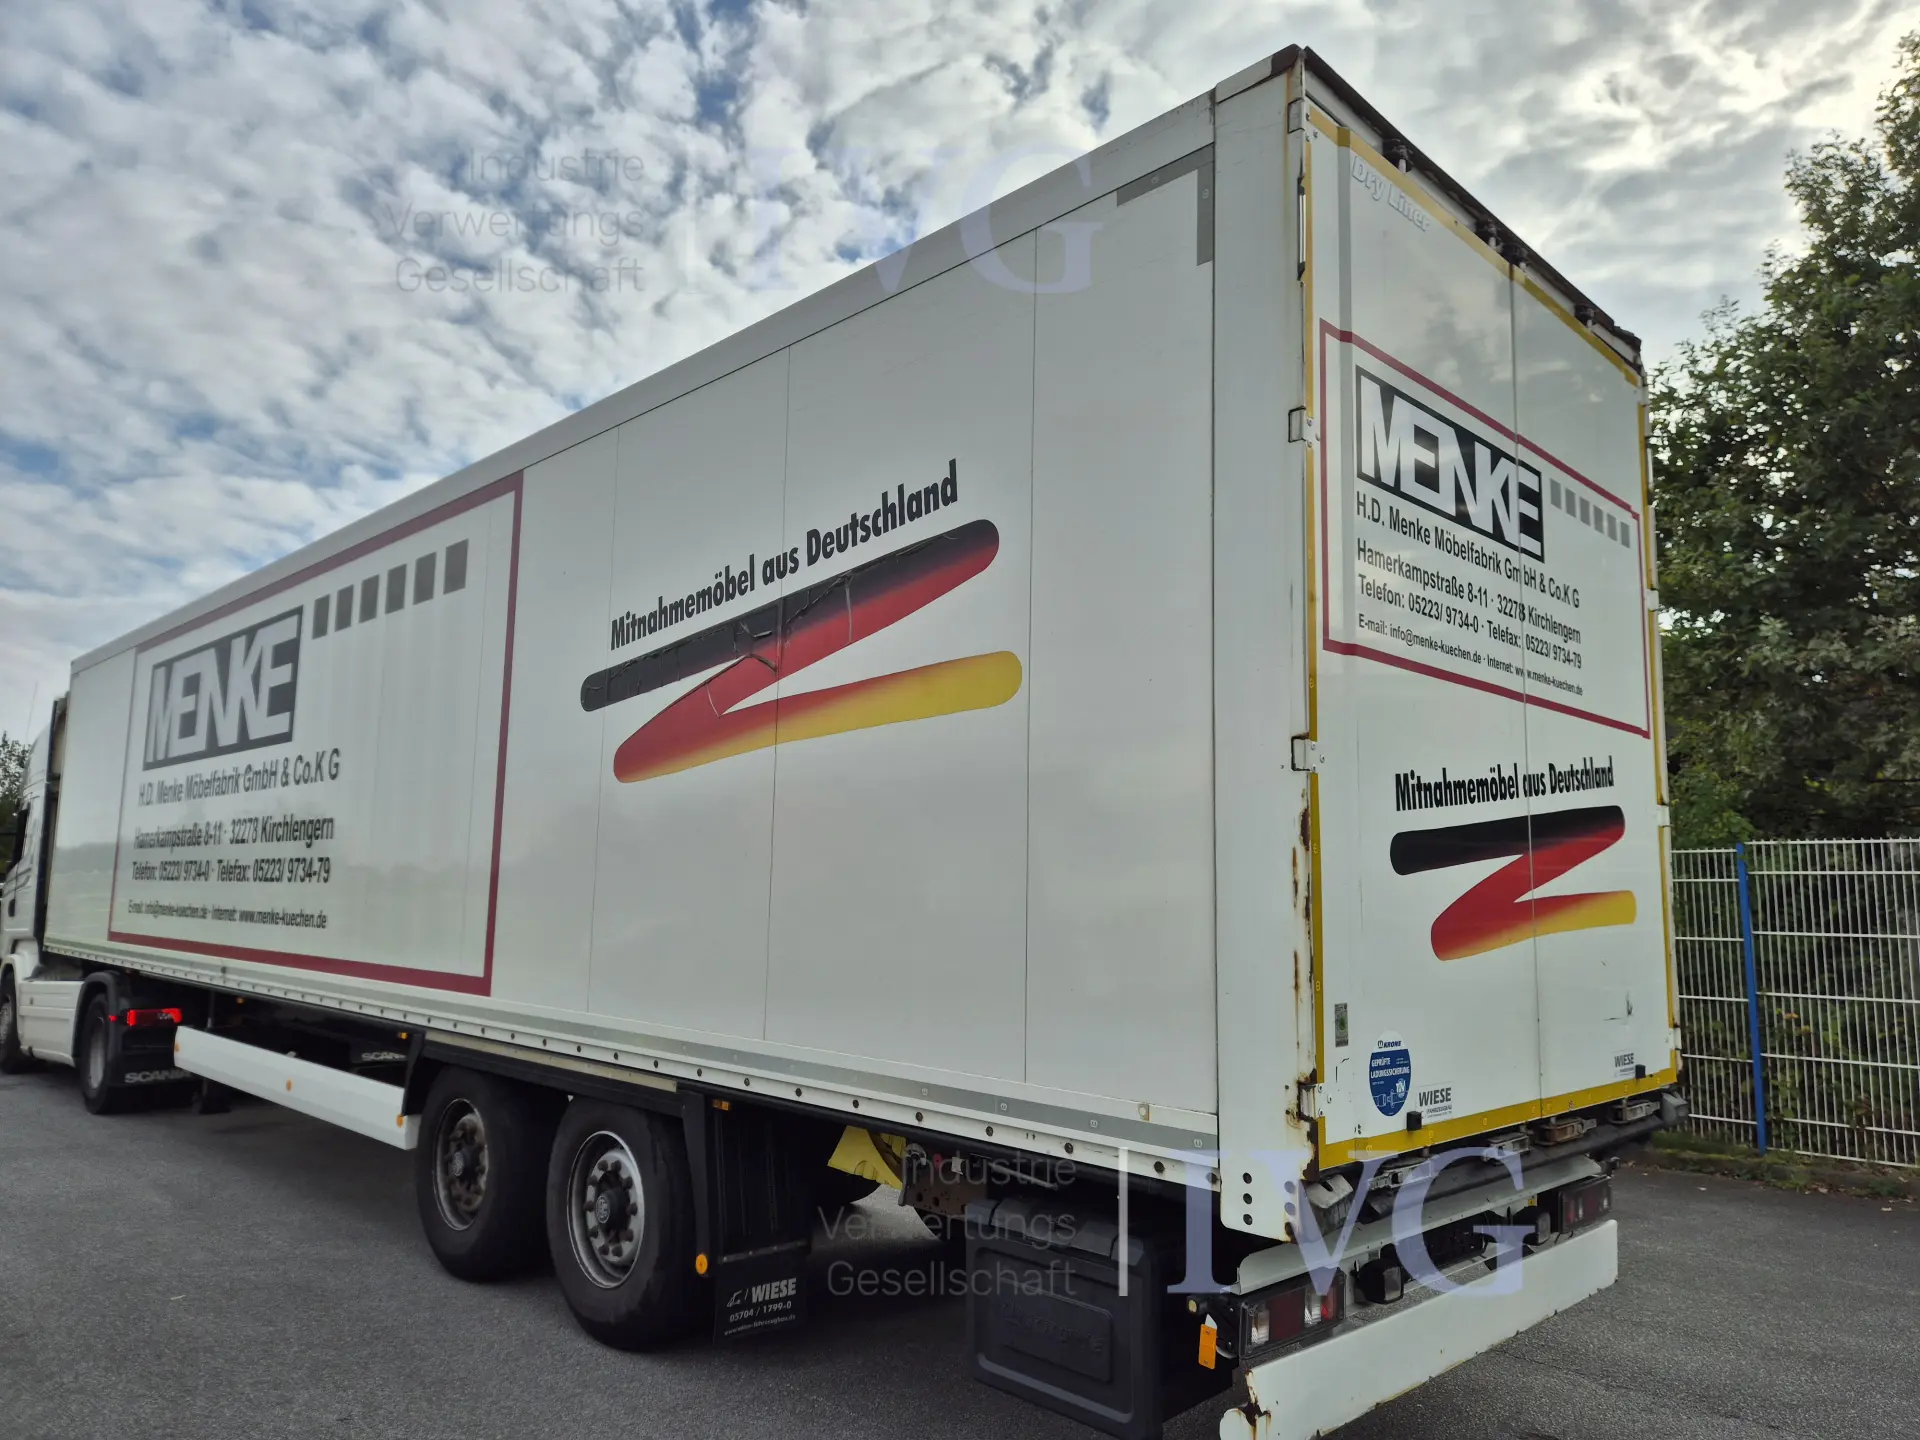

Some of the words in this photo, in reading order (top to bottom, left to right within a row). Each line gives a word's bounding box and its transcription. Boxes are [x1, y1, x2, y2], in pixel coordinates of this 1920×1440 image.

[1352, 156, 1386, 201] Dry
[1360, 374, 1541, 554] MENKE
[610, 552, 755, 651] Mitnahmemöbel
[762, 547, 799, 586] aus
[806, 458, 958, 567] Deutschland
[1356, 493, 1385, 526] H.D.
[1389, 505, 1431, 545] Menke
[1434, 525, 1501, 576] Möbelfabrik
[1539, 573, 1547, 593] &
[1357, 537, 1464, 600] Hamerkampstraße
[1467, 582, 1488, 609] 8-11
[1497, 594, 1526, 622] 32278
[1528, 605, 1581, 644] Kirchlengern
[1358, 573, 1405, 608] Telefon:
[1445, 608, 1479, 633] 9734-0
[1487, 620, 1522, 648] Telefax:
[1553, 644, 1582, 669] 9734-79
[1358, 613, 1388, 636] E-mail:
[1389, 624, 1482, 664] info@menke-kuechen.de
[1487, 655, 1514, 675] Internet:
[146, 612, 300, 763] MENKE
[156, 779, 184, 804] Menke
[185, 766, 240, 801] Möbelfabrik
[243, 758, 279, 792] GmbH
[280, 756, 289, 787] &
[1395, 762, 1520, 811] Mitnahmemöbel
[1522, 771, 1547, 797] aus
[1549, 755, 1614, 795] Deutschland
[203, 820, 223, 846] 8-11
[229, 816, 259, 845] 32278
[261, 814, 334, 848] Kirchlengern
[217, 859, 250, 882] Telefax:
[287, 857, 331, 884] 9734-79
[238, 907, 327, 929] www.menke-kuechen.de
[1419, 1087, 1452, 1107] WIESE
[729, 1309, 754, 1323] 05704
[763, 1300, 792, 1314] 1799-0
[752, 1277, 797, 1303] WIESE
